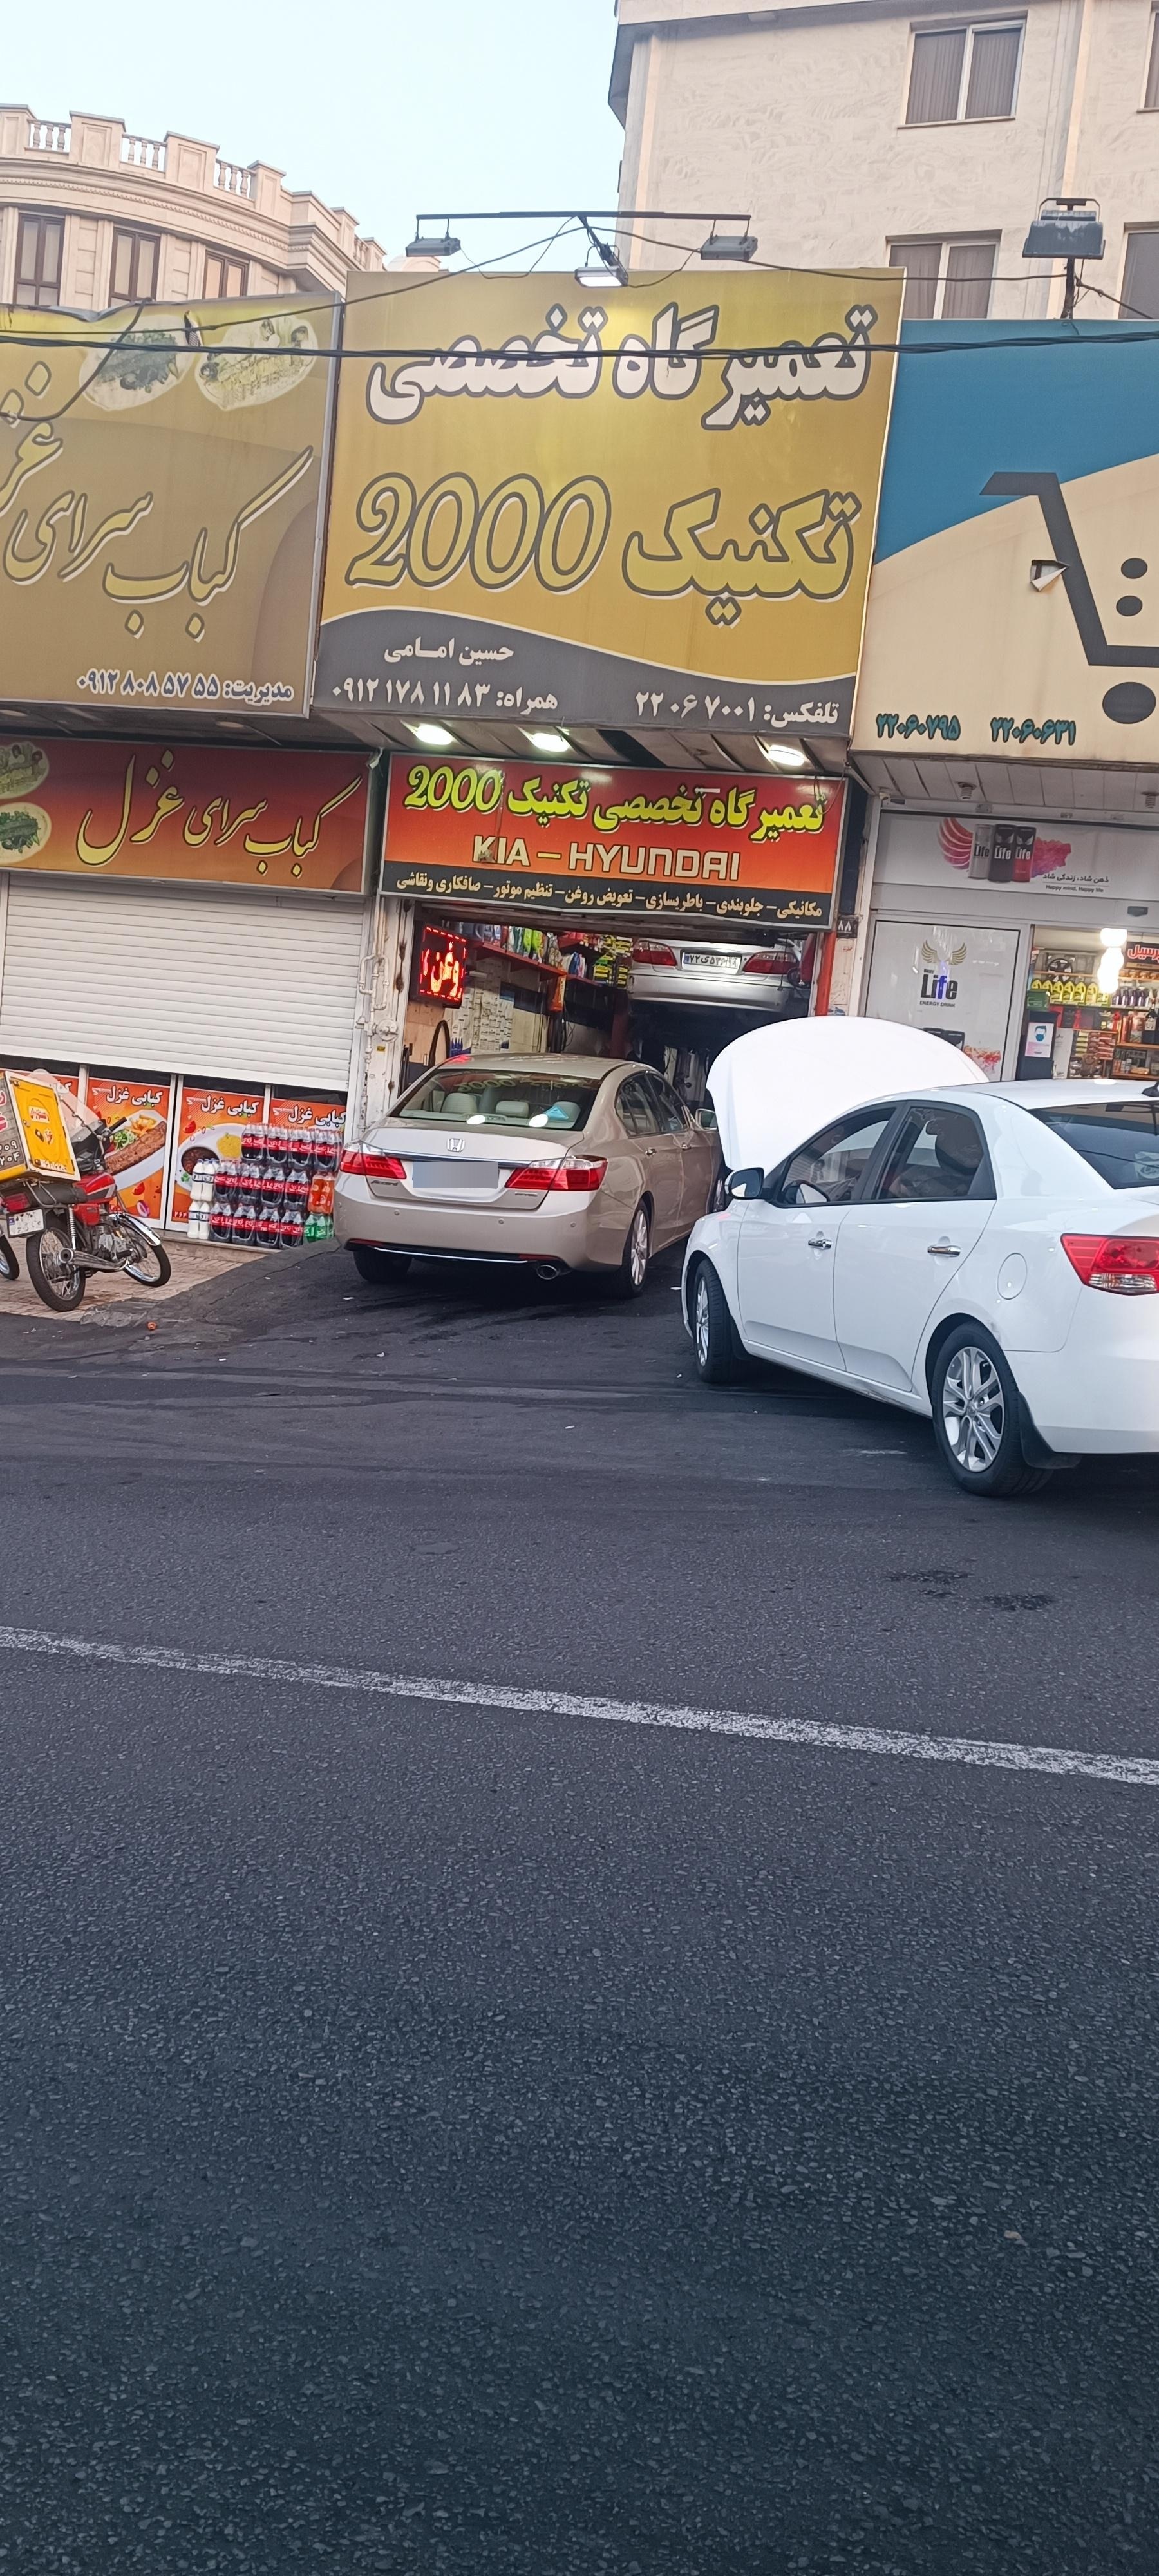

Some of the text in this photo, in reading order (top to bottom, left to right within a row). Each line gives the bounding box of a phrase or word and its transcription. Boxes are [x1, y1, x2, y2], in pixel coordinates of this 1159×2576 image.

[365, 301, 878, 431] تعمیر گاه تخصصی
[0, 360, 314, 641] کباب سرای غز
[344, 471, 862, 629] تکنیک 2000
[458, 645, 514, 665] حسین
[77, 668, 293, 705] مدیریت: ۰۹۱۲ ۸۰۸ ۵۷ ۵۵
[332, 677, 558, 715] همراه: ۰۹۱۲ ۱۷۸ ۱۱ ۸۳
[763, 701, 840, 728] تلفکس:
[876, 714, 961, 741] ۲۲۰۶۰۷۹۵
[76, 750, 363, 879] کباب سرای غزل
[404, 764, 827, 843] تعمیر گاه تخصصی تکنیک 2000
[472, 835, 531, 867] KIA
[568, 842, 741, 882] HYUNDAI
[436, 875, 481, 893] صافکاری
[524, 882, 553, 900] تنظیم
[1127, 944, 1159, 963] رسیل
[921, 974, 958, 1000] Life
[106, 1085, 164, 1107] کبابی غزل
[201, 1095, 259, 1117] کبابی غزل
[288, 1104, 314, 1124] غزل
